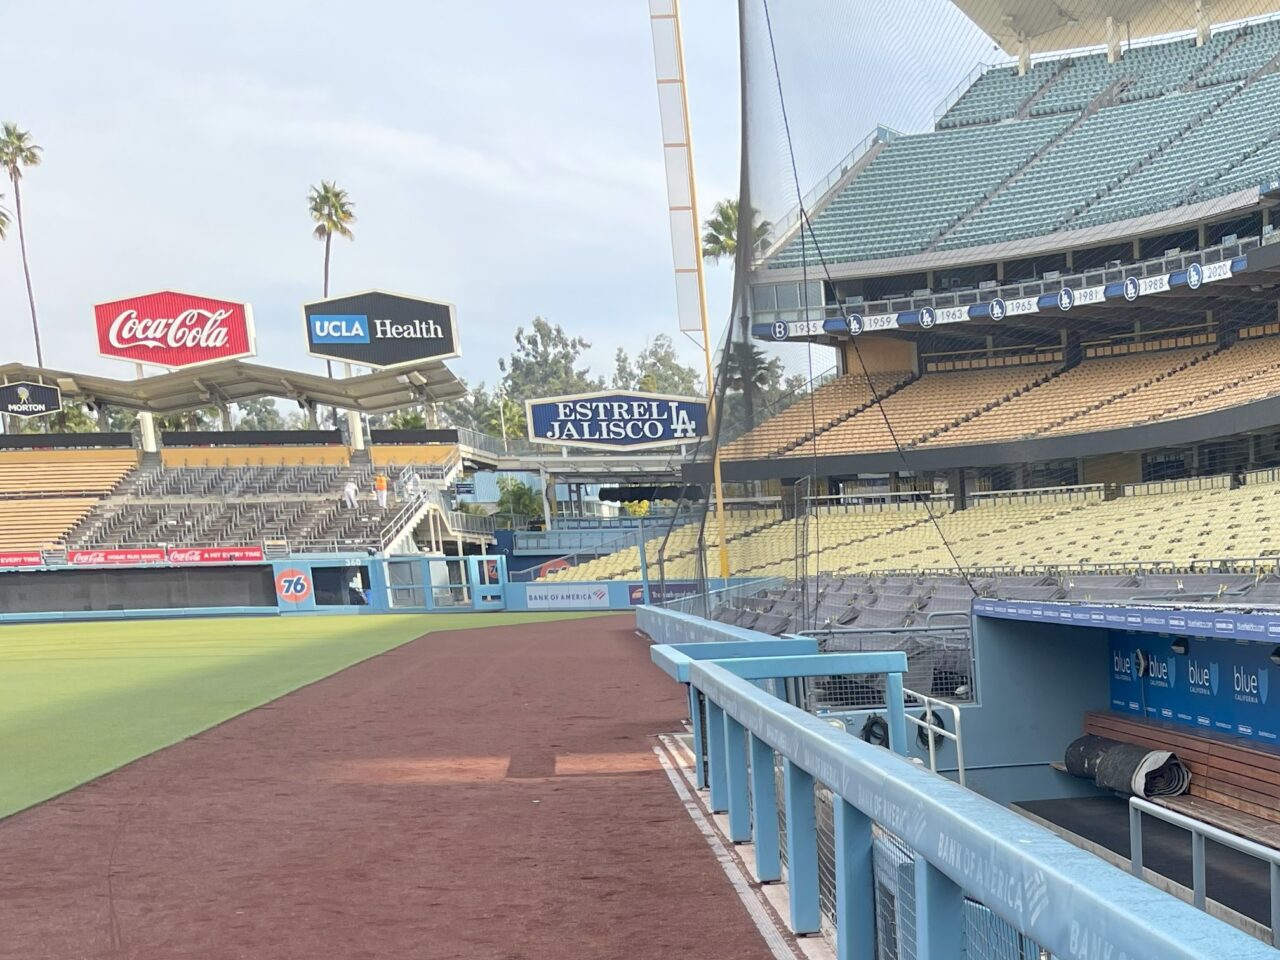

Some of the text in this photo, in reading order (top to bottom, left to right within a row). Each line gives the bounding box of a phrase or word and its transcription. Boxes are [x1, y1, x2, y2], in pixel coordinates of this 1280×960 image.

[1207, 264, 1228, 278] 2020
[1144, 278, 1164, 291] 1988
[1078, 291, 1099, 302] 1981
[1011, 301, 1032, 312] 1965
[868, 316, 892, 328] 1959
[940, 309, 963, 320] 1963
[108, 309, 234, 349] Coca-Cola
[315, 319, 444, 339] UCLA Health
[776, 323, 785, 338] B
[7, 403, 46, 412] MORTON
[553, 402, 668, 420] ESTREL
[546, 421, 665, 440] JALISCO
[344, 558, 362, 567] 360
[281, 576, 306, 596] 76
[551, 593, 559, 601] OF
[559, 593, 592, 601] AMERICA
[1113, 651, 1131, 673] blue
[1149, 654, 1168, 679] blue
[1188, 659, 1210, 687] blue
[1233, 665, 1258, 694] blue
[1234, 693, 1258, 704] CALIFORNIA
[938, 831, 1023, 913] BANK OF AMERICA
